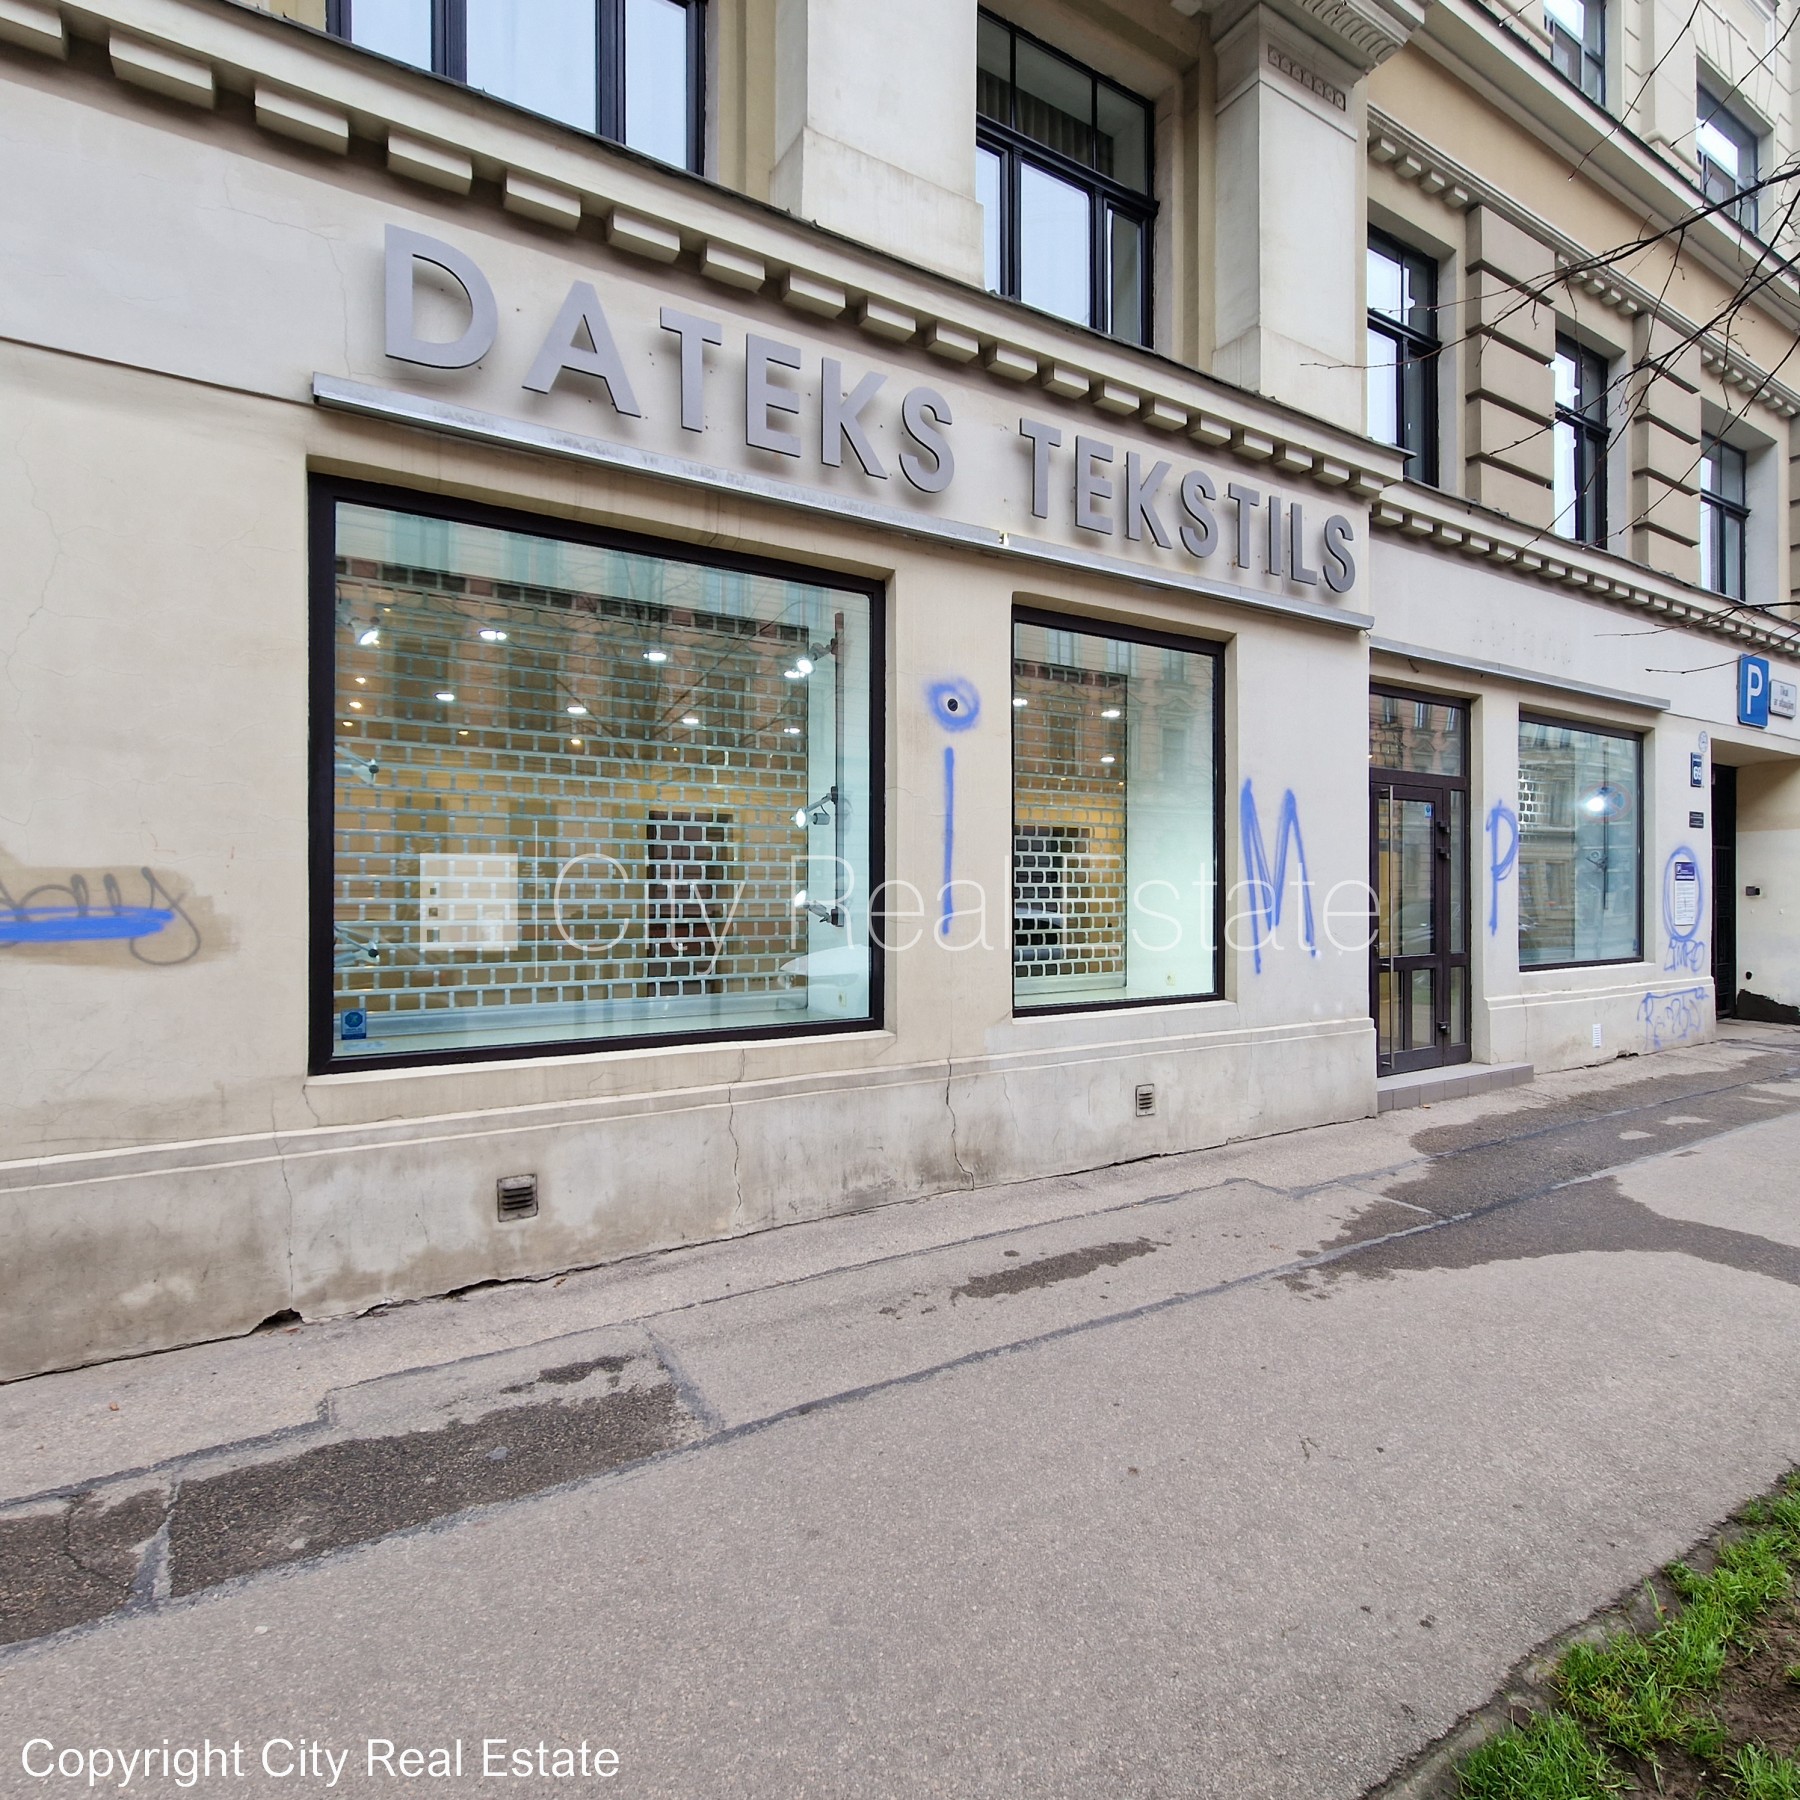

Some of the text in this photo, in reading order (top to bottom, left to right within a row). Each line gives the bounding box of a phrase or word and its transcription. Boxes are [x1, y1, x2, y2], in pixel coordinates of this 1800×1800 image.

[384, 223, 1356, 593] DATEKS TEKSTILS
[1746, 664, 1763, 715] P
[1240, 778, 1317, 974] M
[1486, 799, 1519, 936] P
